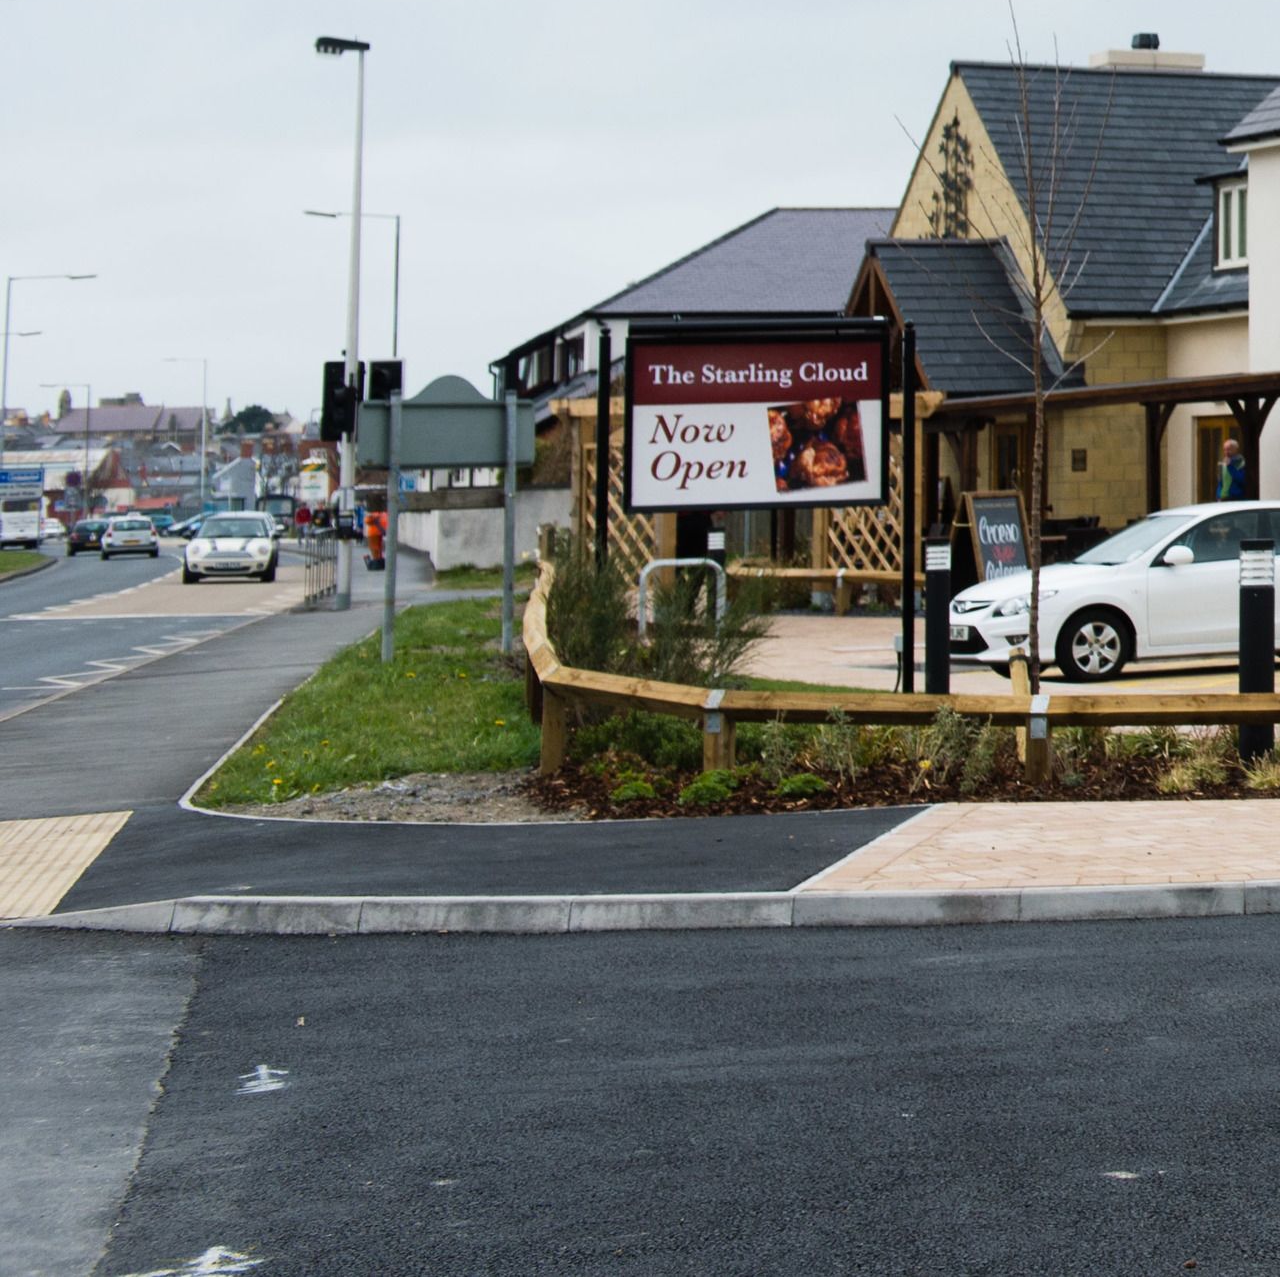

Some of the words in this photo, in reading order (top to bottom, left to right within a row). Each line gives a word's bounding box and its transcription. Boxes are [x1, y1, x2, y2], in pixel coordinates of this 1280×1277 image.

[648, 364, 695, 385] The
[701, 363, 793, 388] Starling
[799, 361, 869, 382] Cloud
[648, 413, 735, 444] Now
[650, 450, 749, 490] Open
